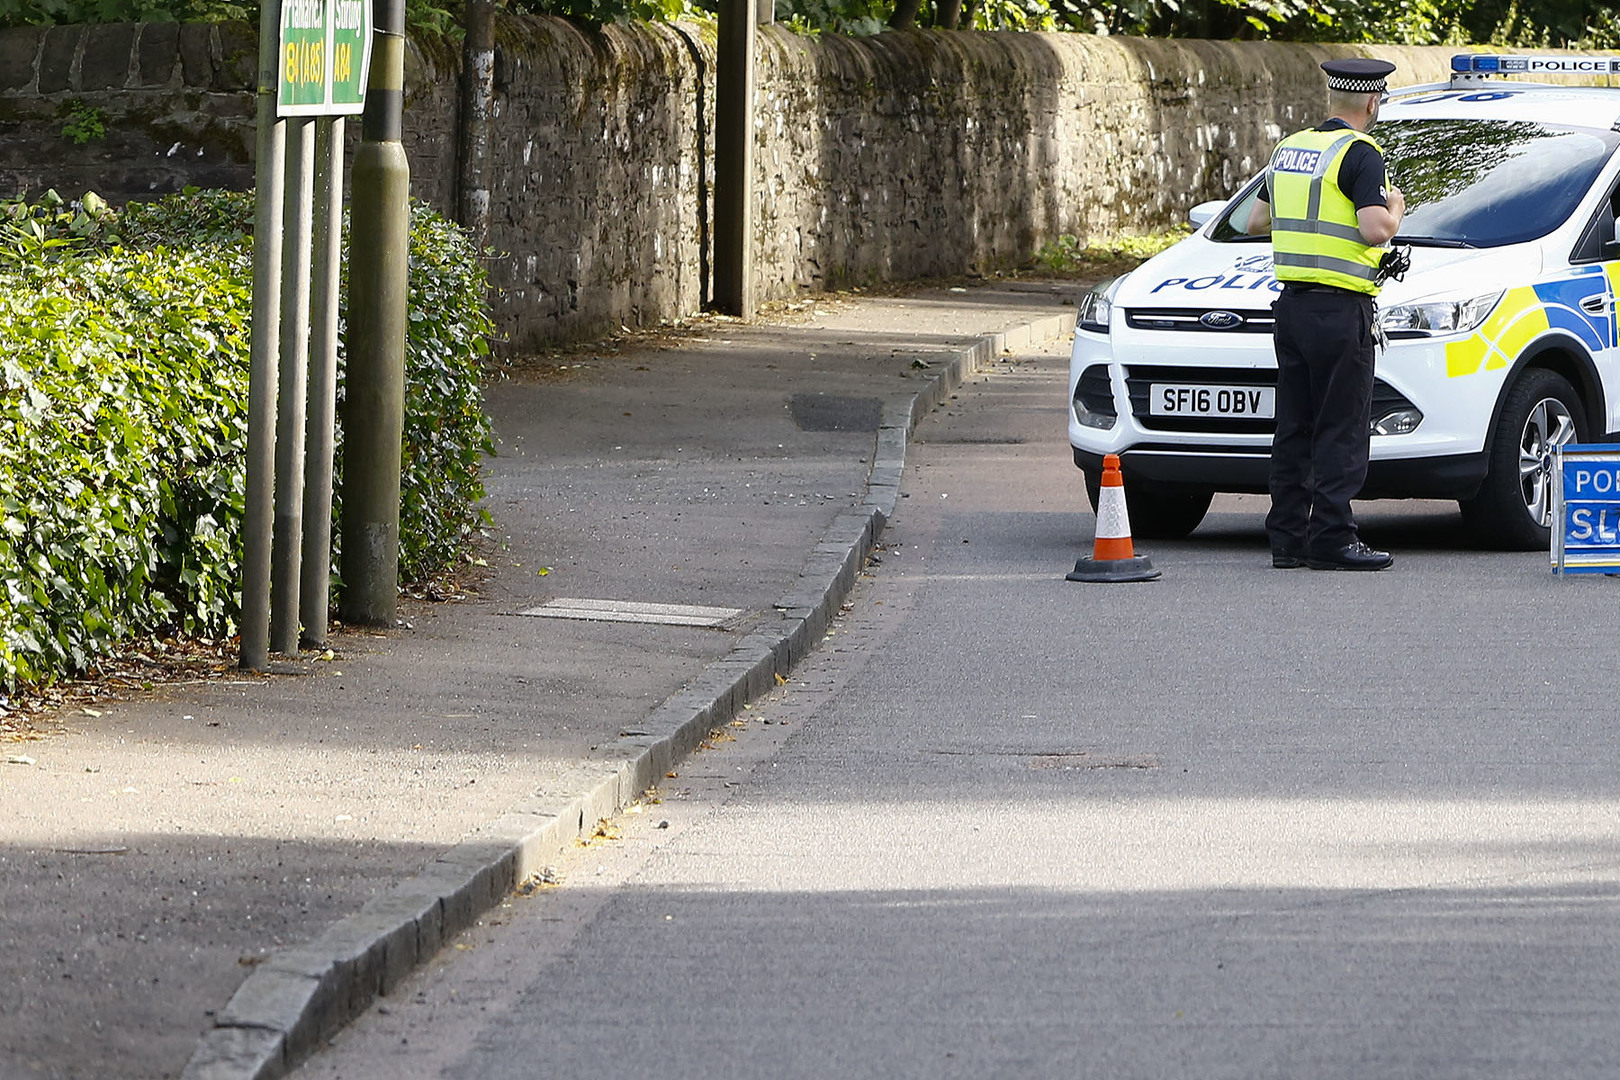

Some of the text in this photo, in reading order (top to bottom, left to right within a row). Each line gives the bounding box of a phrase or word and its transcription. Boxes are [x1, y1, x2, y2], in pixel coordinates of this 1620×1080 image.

[334, 42, 352, 82] A84
[1532, 61, 1606, 71] POLICE
[1275, 149, 1318, 172] POLICE
[1207, 312, 1232, 325] Ford
[1163, 388, 1261, 413] SF16 OBV
